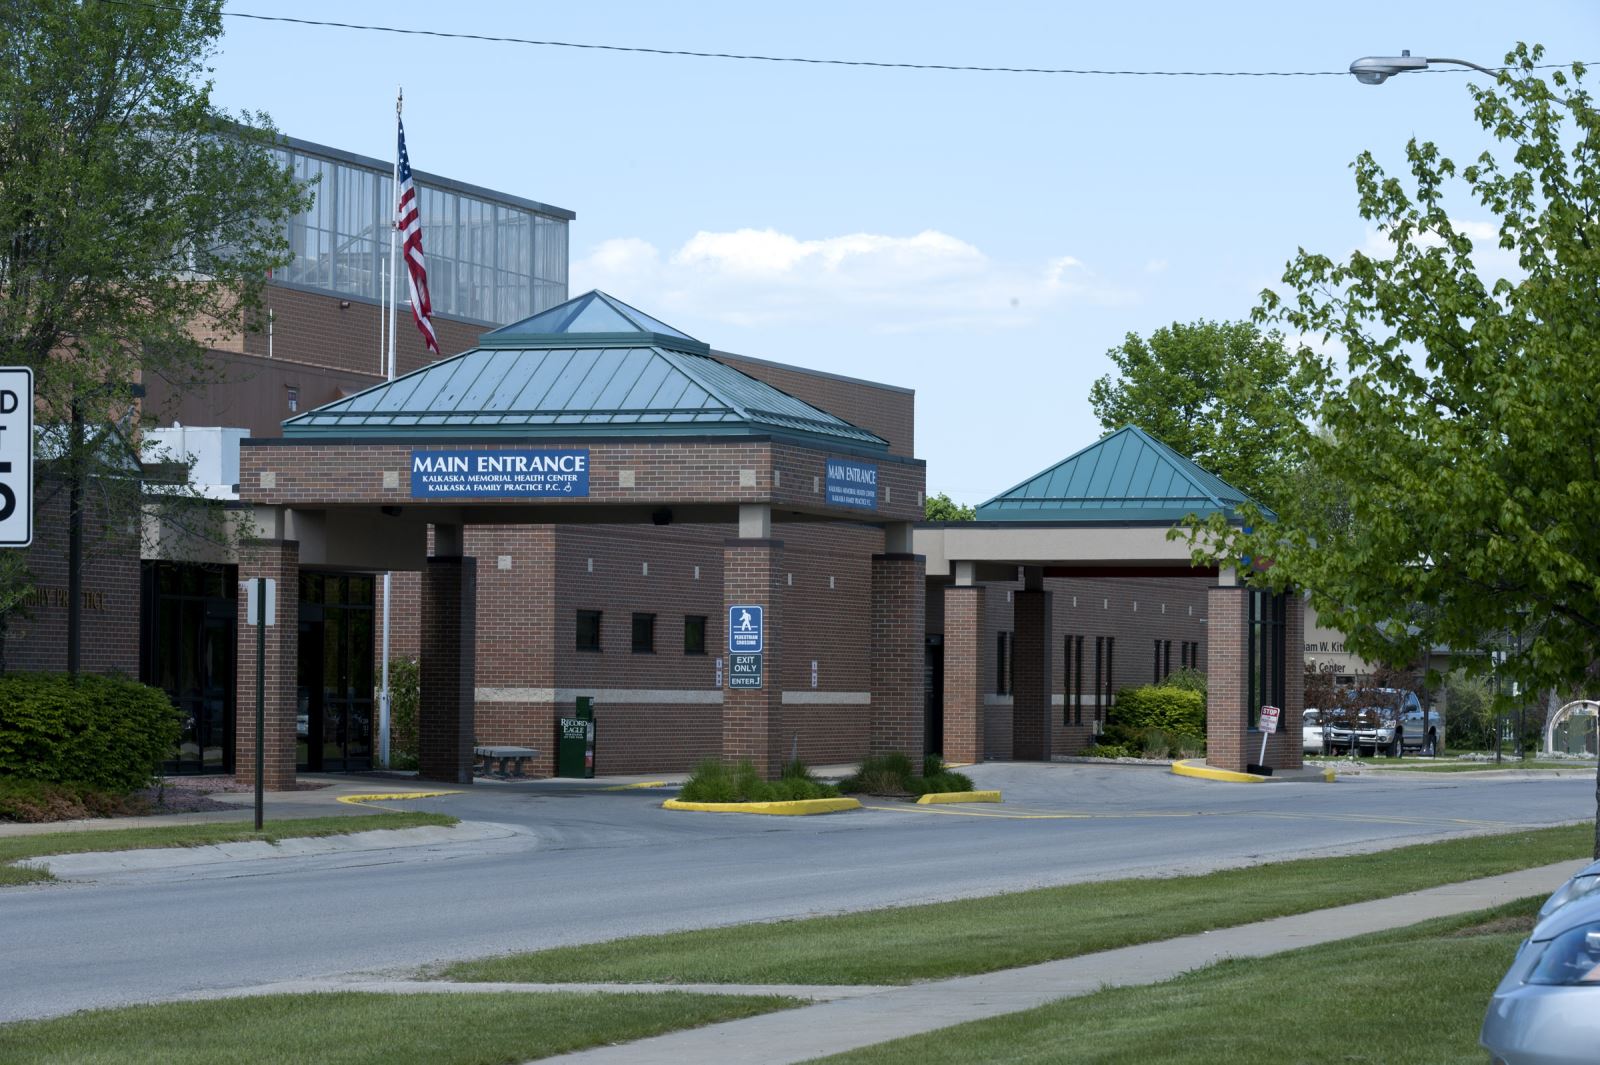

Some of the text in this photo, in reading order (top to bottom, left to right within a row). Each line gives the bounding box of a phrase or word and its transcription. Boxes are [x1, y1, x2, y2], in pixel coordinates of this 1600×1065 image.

[413, 456, 585, 473] MAIN ENTRANCE
[422, 475, 465, 483] KALKASKA
[514, 474, 544, 482] HEALTH
[547, 474, 578, 482] CENTER
[828, 464, 876, 485] MAIN ENTRANCE
[1319, 641, 1330, 652] W.
[736, 656, 755, 664] EXIT
[1319, 662, 1346, 673] Center
[1262, 707, 1278, 716] STOP
